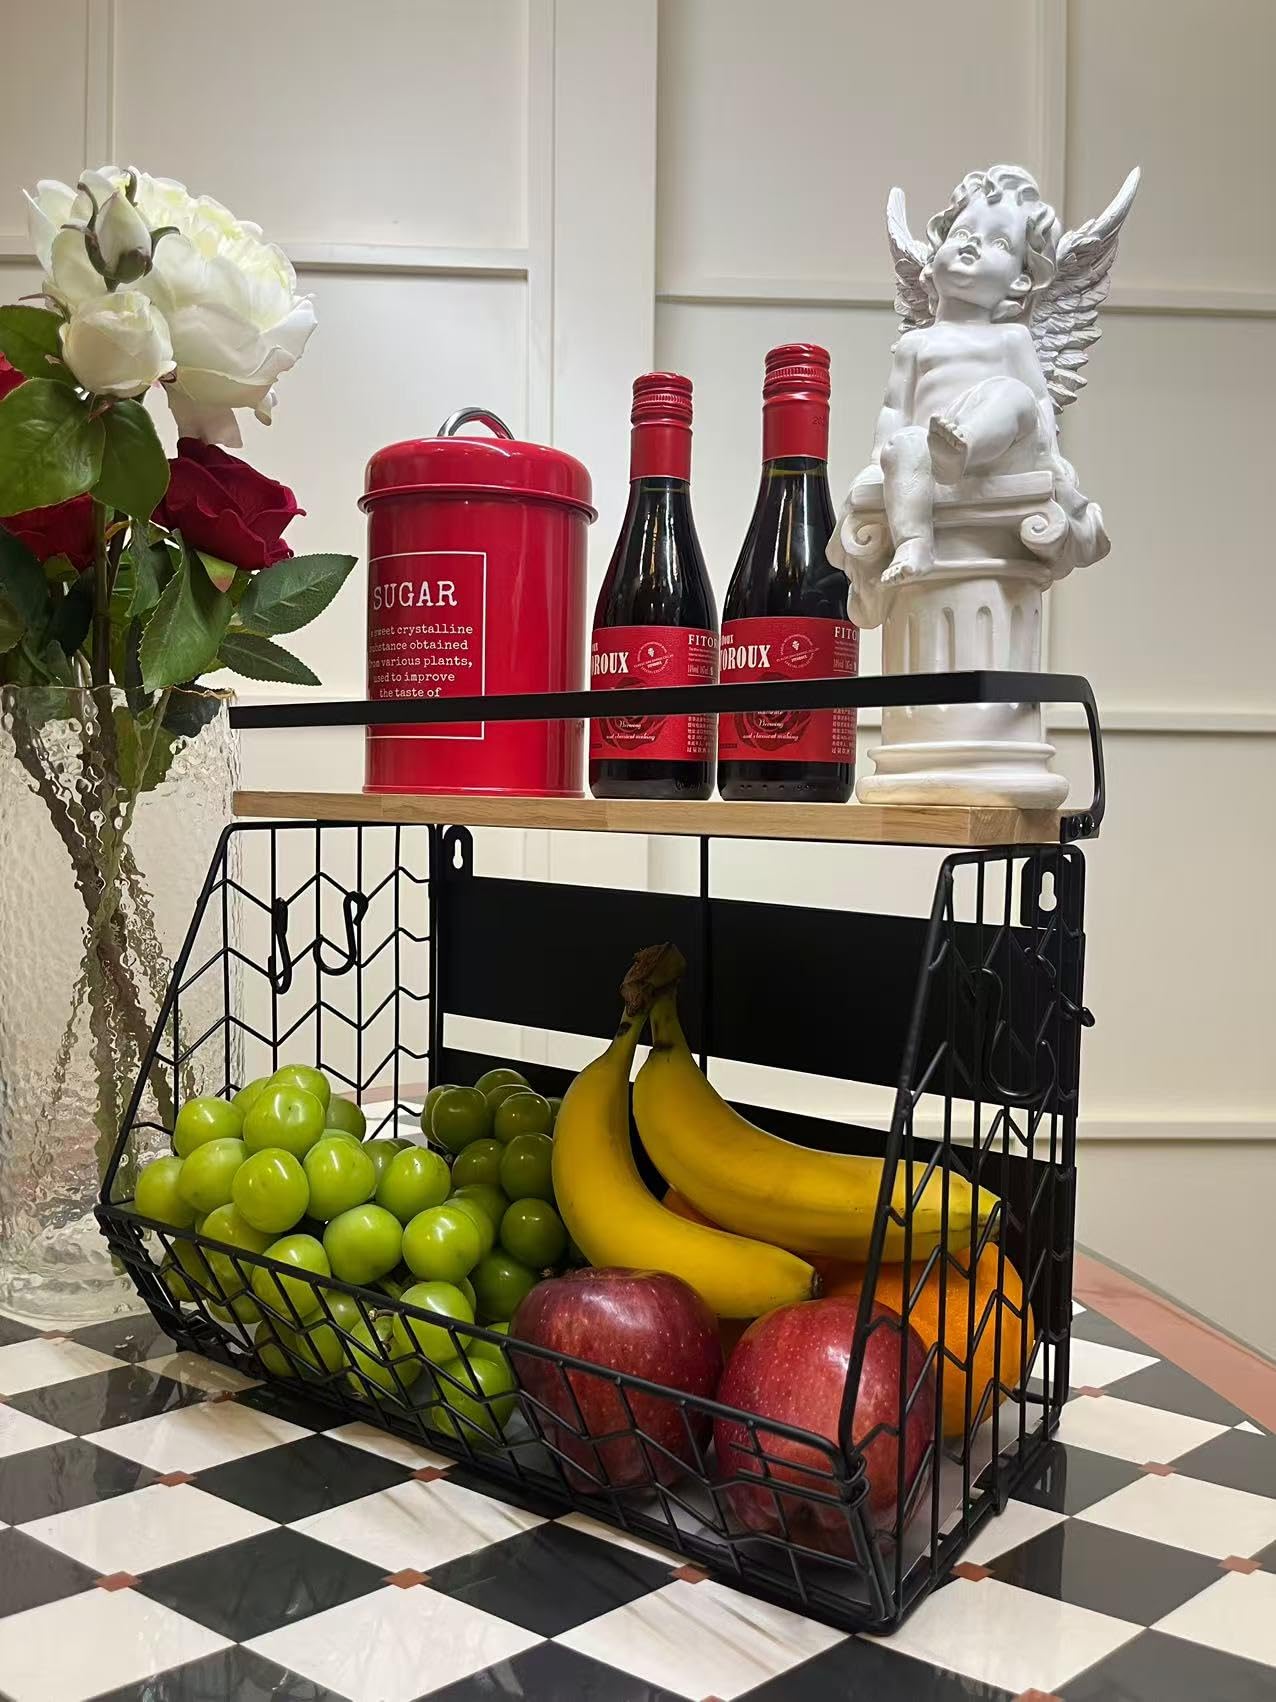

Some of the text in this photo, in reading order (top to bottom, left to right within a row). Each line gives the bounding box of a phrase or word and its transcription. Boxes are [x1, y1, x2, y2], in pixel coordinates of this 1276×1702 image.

[373, 580, 458, 610] SUGAR
[397, 623, 474, 637] crystalline
[409, 640, 469, 650] obtained
[381, 656, 421, 667] various
[423, 655, 474, 668] plants,
[373, 671, 456, 684] used to improve
[379, 686, 442, 698] the taste of
